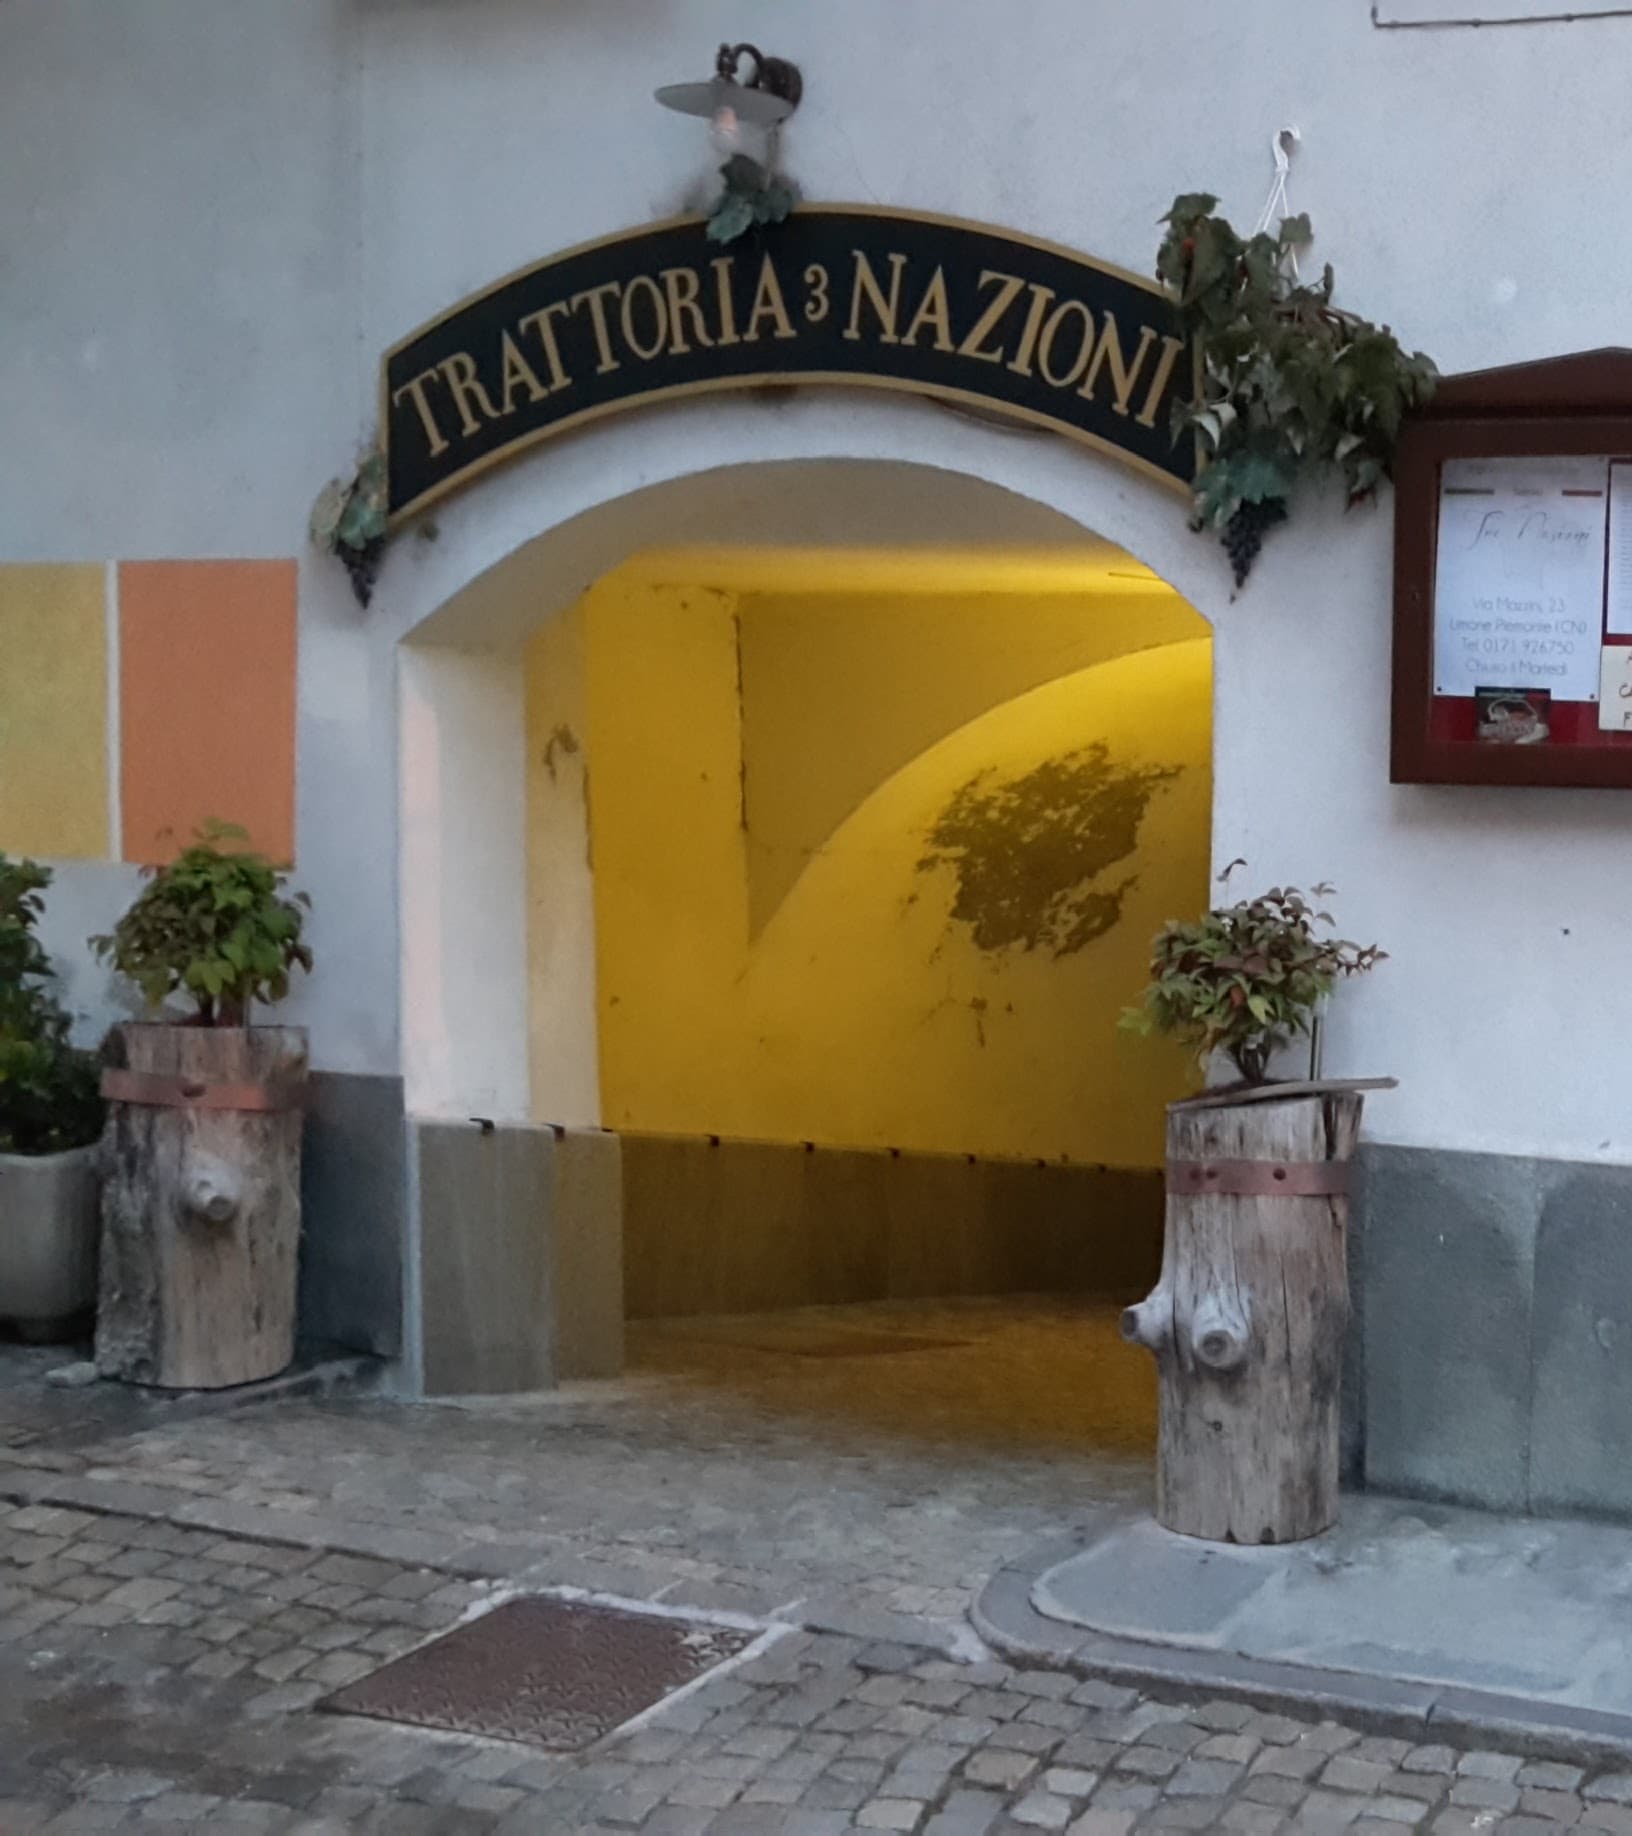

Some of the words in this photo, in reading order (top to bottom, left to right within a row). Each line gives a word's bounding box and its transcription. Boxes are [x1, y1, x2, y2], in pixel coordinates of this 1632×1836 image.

[393, 250, 798, 459] TRATTORIA
[803, 262, 831, 324] 3
[843, 249, 1186, 429] NAZIONI
[1472, 596, 1493, 611] Via
[1548, 597, 1567, 613] 23
[1496, 618, 1552, 633] Piemonte
